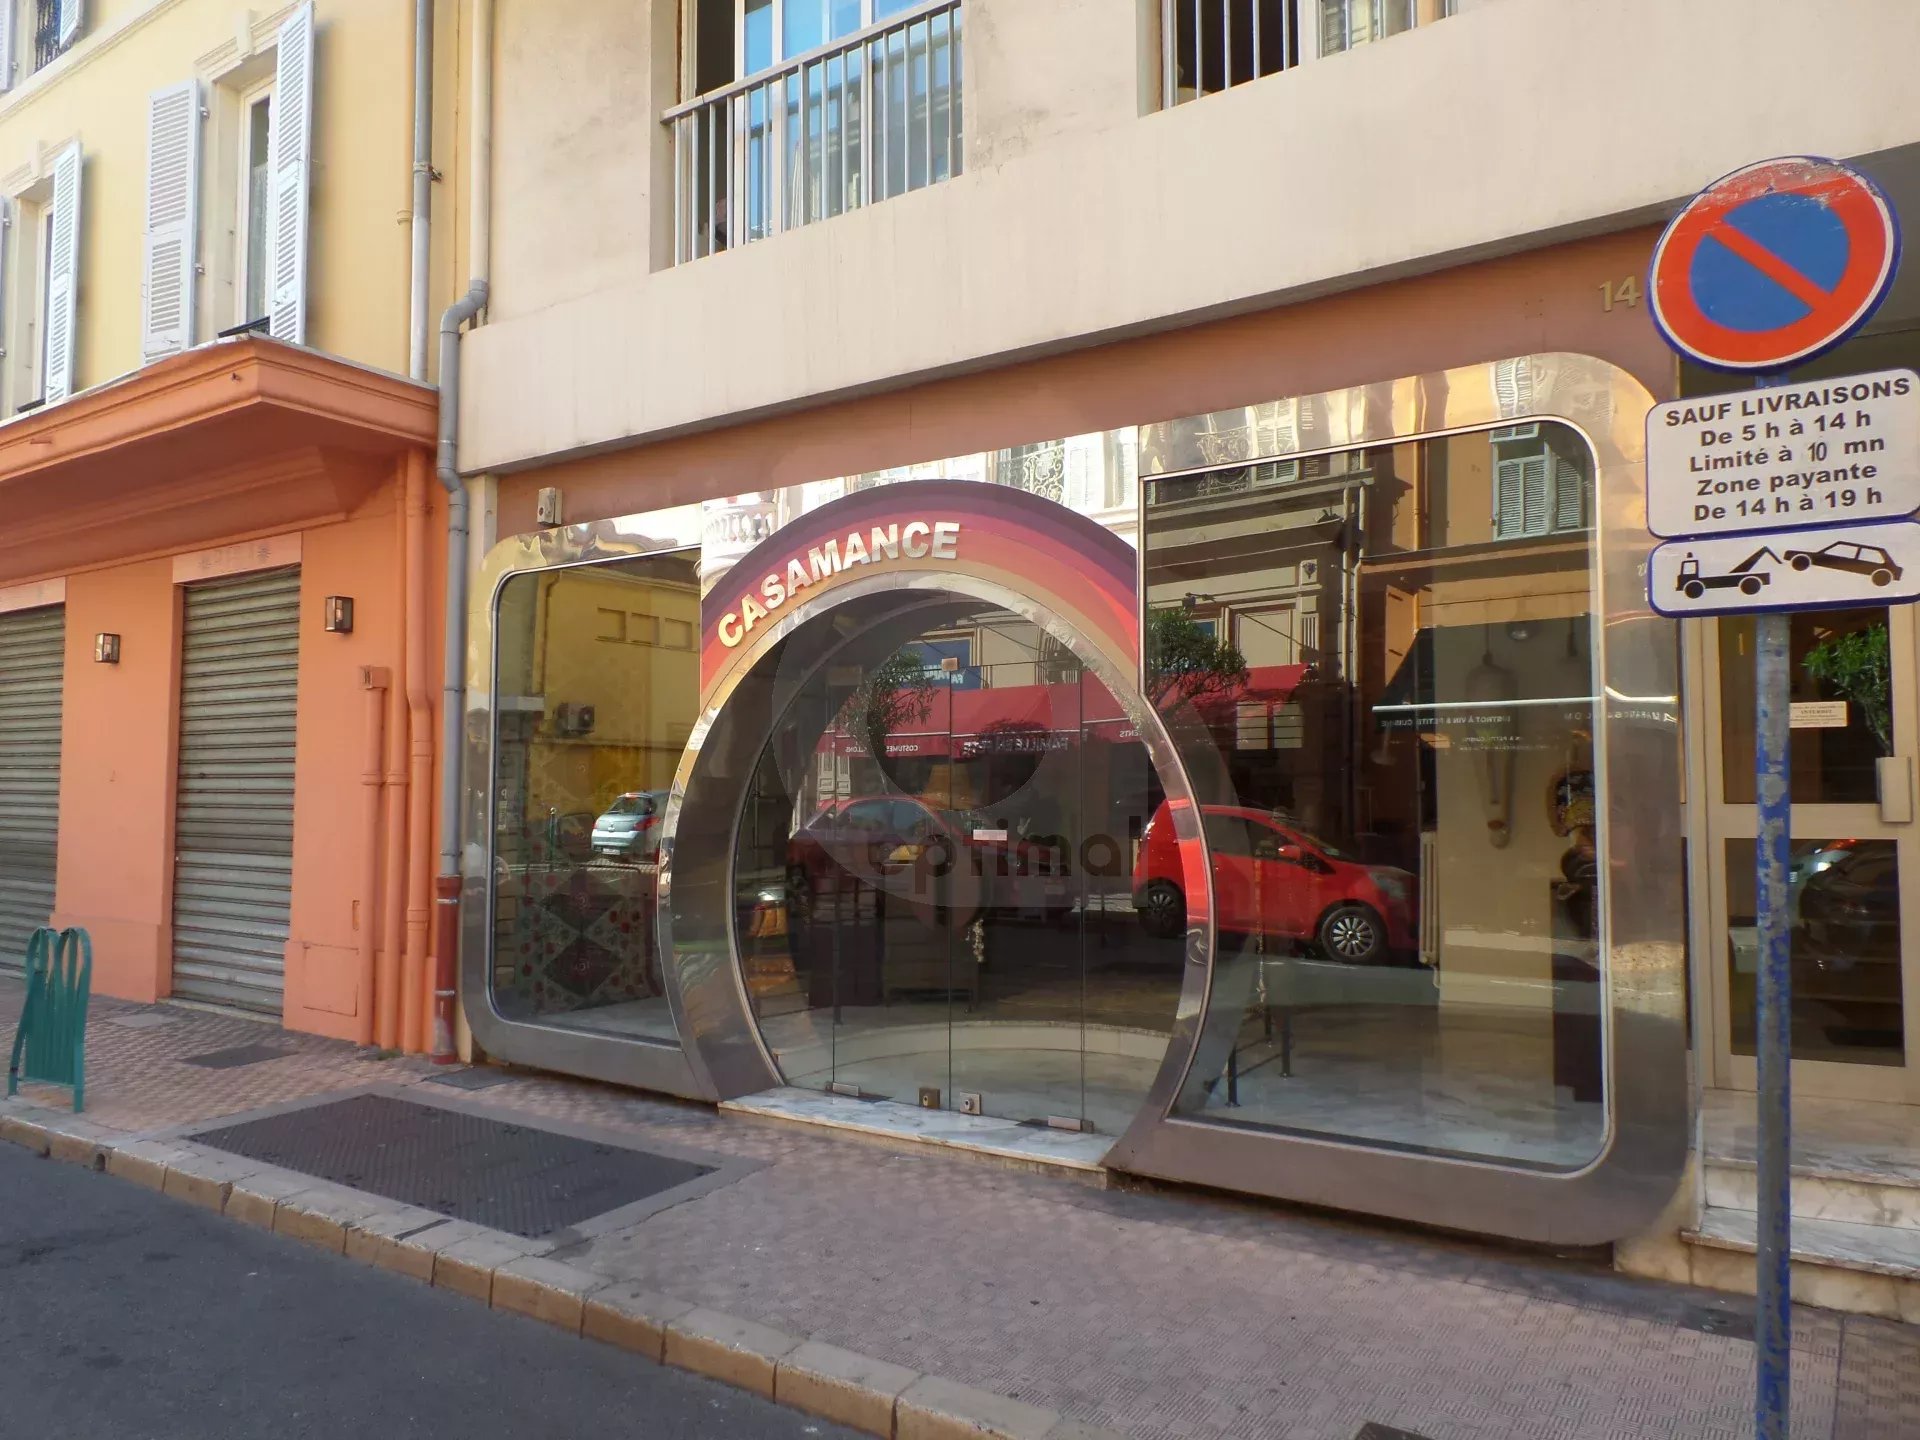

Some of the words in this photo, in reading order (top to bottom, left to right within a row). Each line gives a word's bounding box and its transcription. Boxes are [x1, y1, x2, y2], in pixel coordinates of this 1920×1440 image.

[1599, 275, 1641, 312] 14
[1666, 402, 1732, 427] SAUF
[1741, 377, 1910, 417] LIVRAISONS
[1700, 430, 1733, 447] De
[1742, 424, 1756, 442] 5
[1765, 422, 1780, 439] h
[1789, 418, 1804, 436] à
[1814, 412, 1846, 432] 14
[1856, 410, 1871, 428] h
[1690, 448, 1769, 472] Limité
[1778, 446, 1793, 462] à
[1807, 441, 1828, 463] 10
[1843, 438, 1885, 455] mn
[1696, 478, 1761, 496] Zone
[1770, 462, 1878, 493] payante
[1694, 504, 1726, 522] De
[1736, 498, 1767, 517] 14
[1775, 496, 1790, 514] h
[1799, 494, 1814, 511] à
[1824, 489, 1857, 508] 19
[1867, 487, 1882, 505] h
[717, 521, 960, 648] CASAMANCE
